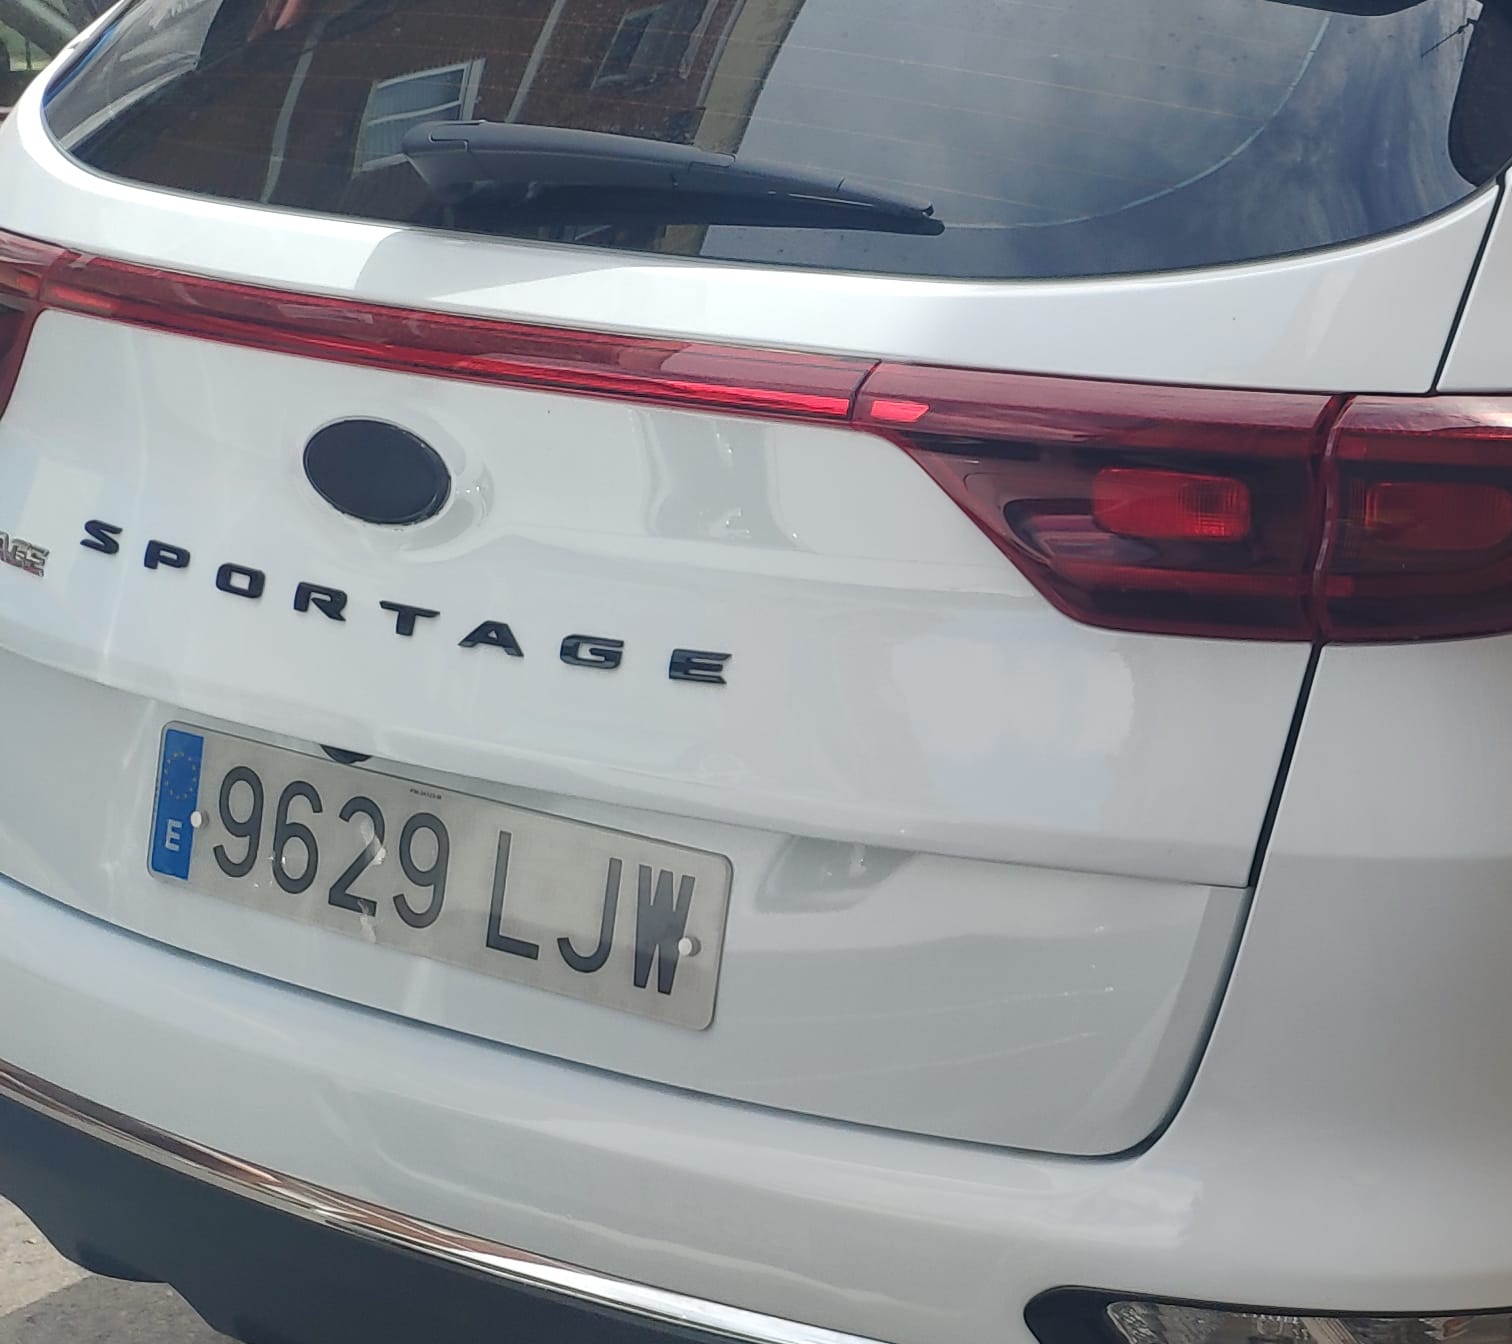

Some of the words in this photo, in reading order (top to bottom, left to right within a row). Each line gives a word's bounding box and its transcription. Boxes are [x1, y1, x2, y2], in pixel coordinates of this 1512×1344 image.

[79, 519, 733, 685] SPORTAGE
[164, 818, 183, 852] E
[211, 765, 450, 930] 9629
[485, 830, 697, 996] LJW
